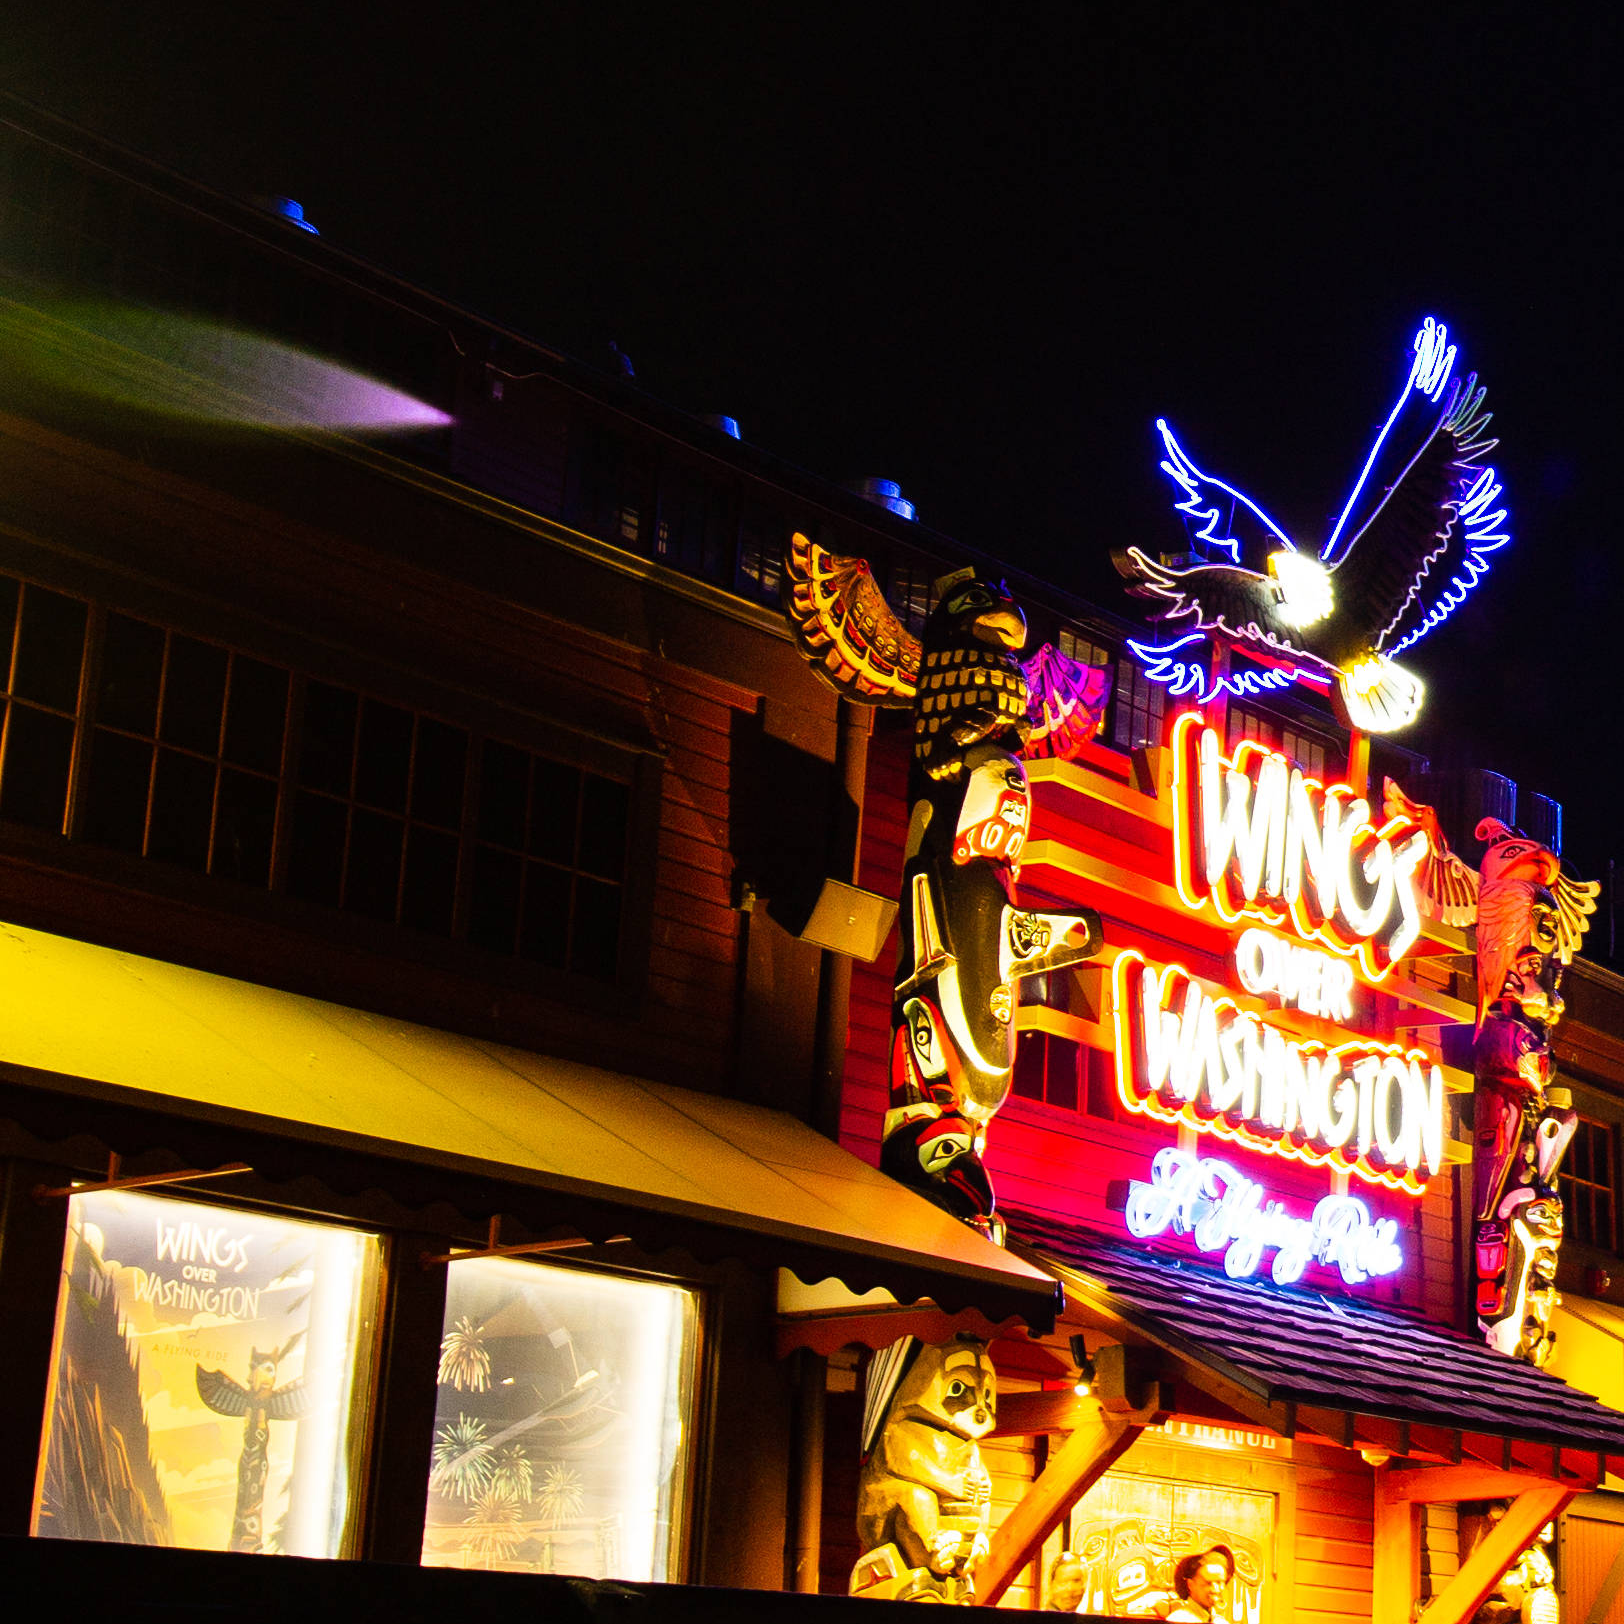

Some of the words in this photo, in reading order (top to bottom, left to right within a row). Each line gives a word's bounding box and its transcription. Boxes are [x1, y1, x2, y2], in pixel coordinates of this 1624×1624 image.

[1198, 727, 1430, 965] WINGS
[1235, 927, 1353, 1022] OVER
[1140, 965, 1444, 1176] WASHINGTON
[1126, 1147, 1201, 1238] A
[156, 1217, 255, 1273] WINGS
[134, 1269, 260, 1319] WASHINGTON
[182, 1265, 216, 1283] OVER
[165, 1343, 201, 1358] FLYING
[206, 1350, 229, 1361] RIDE
[1144, 1419, 1277, 1449] NTRANCE
